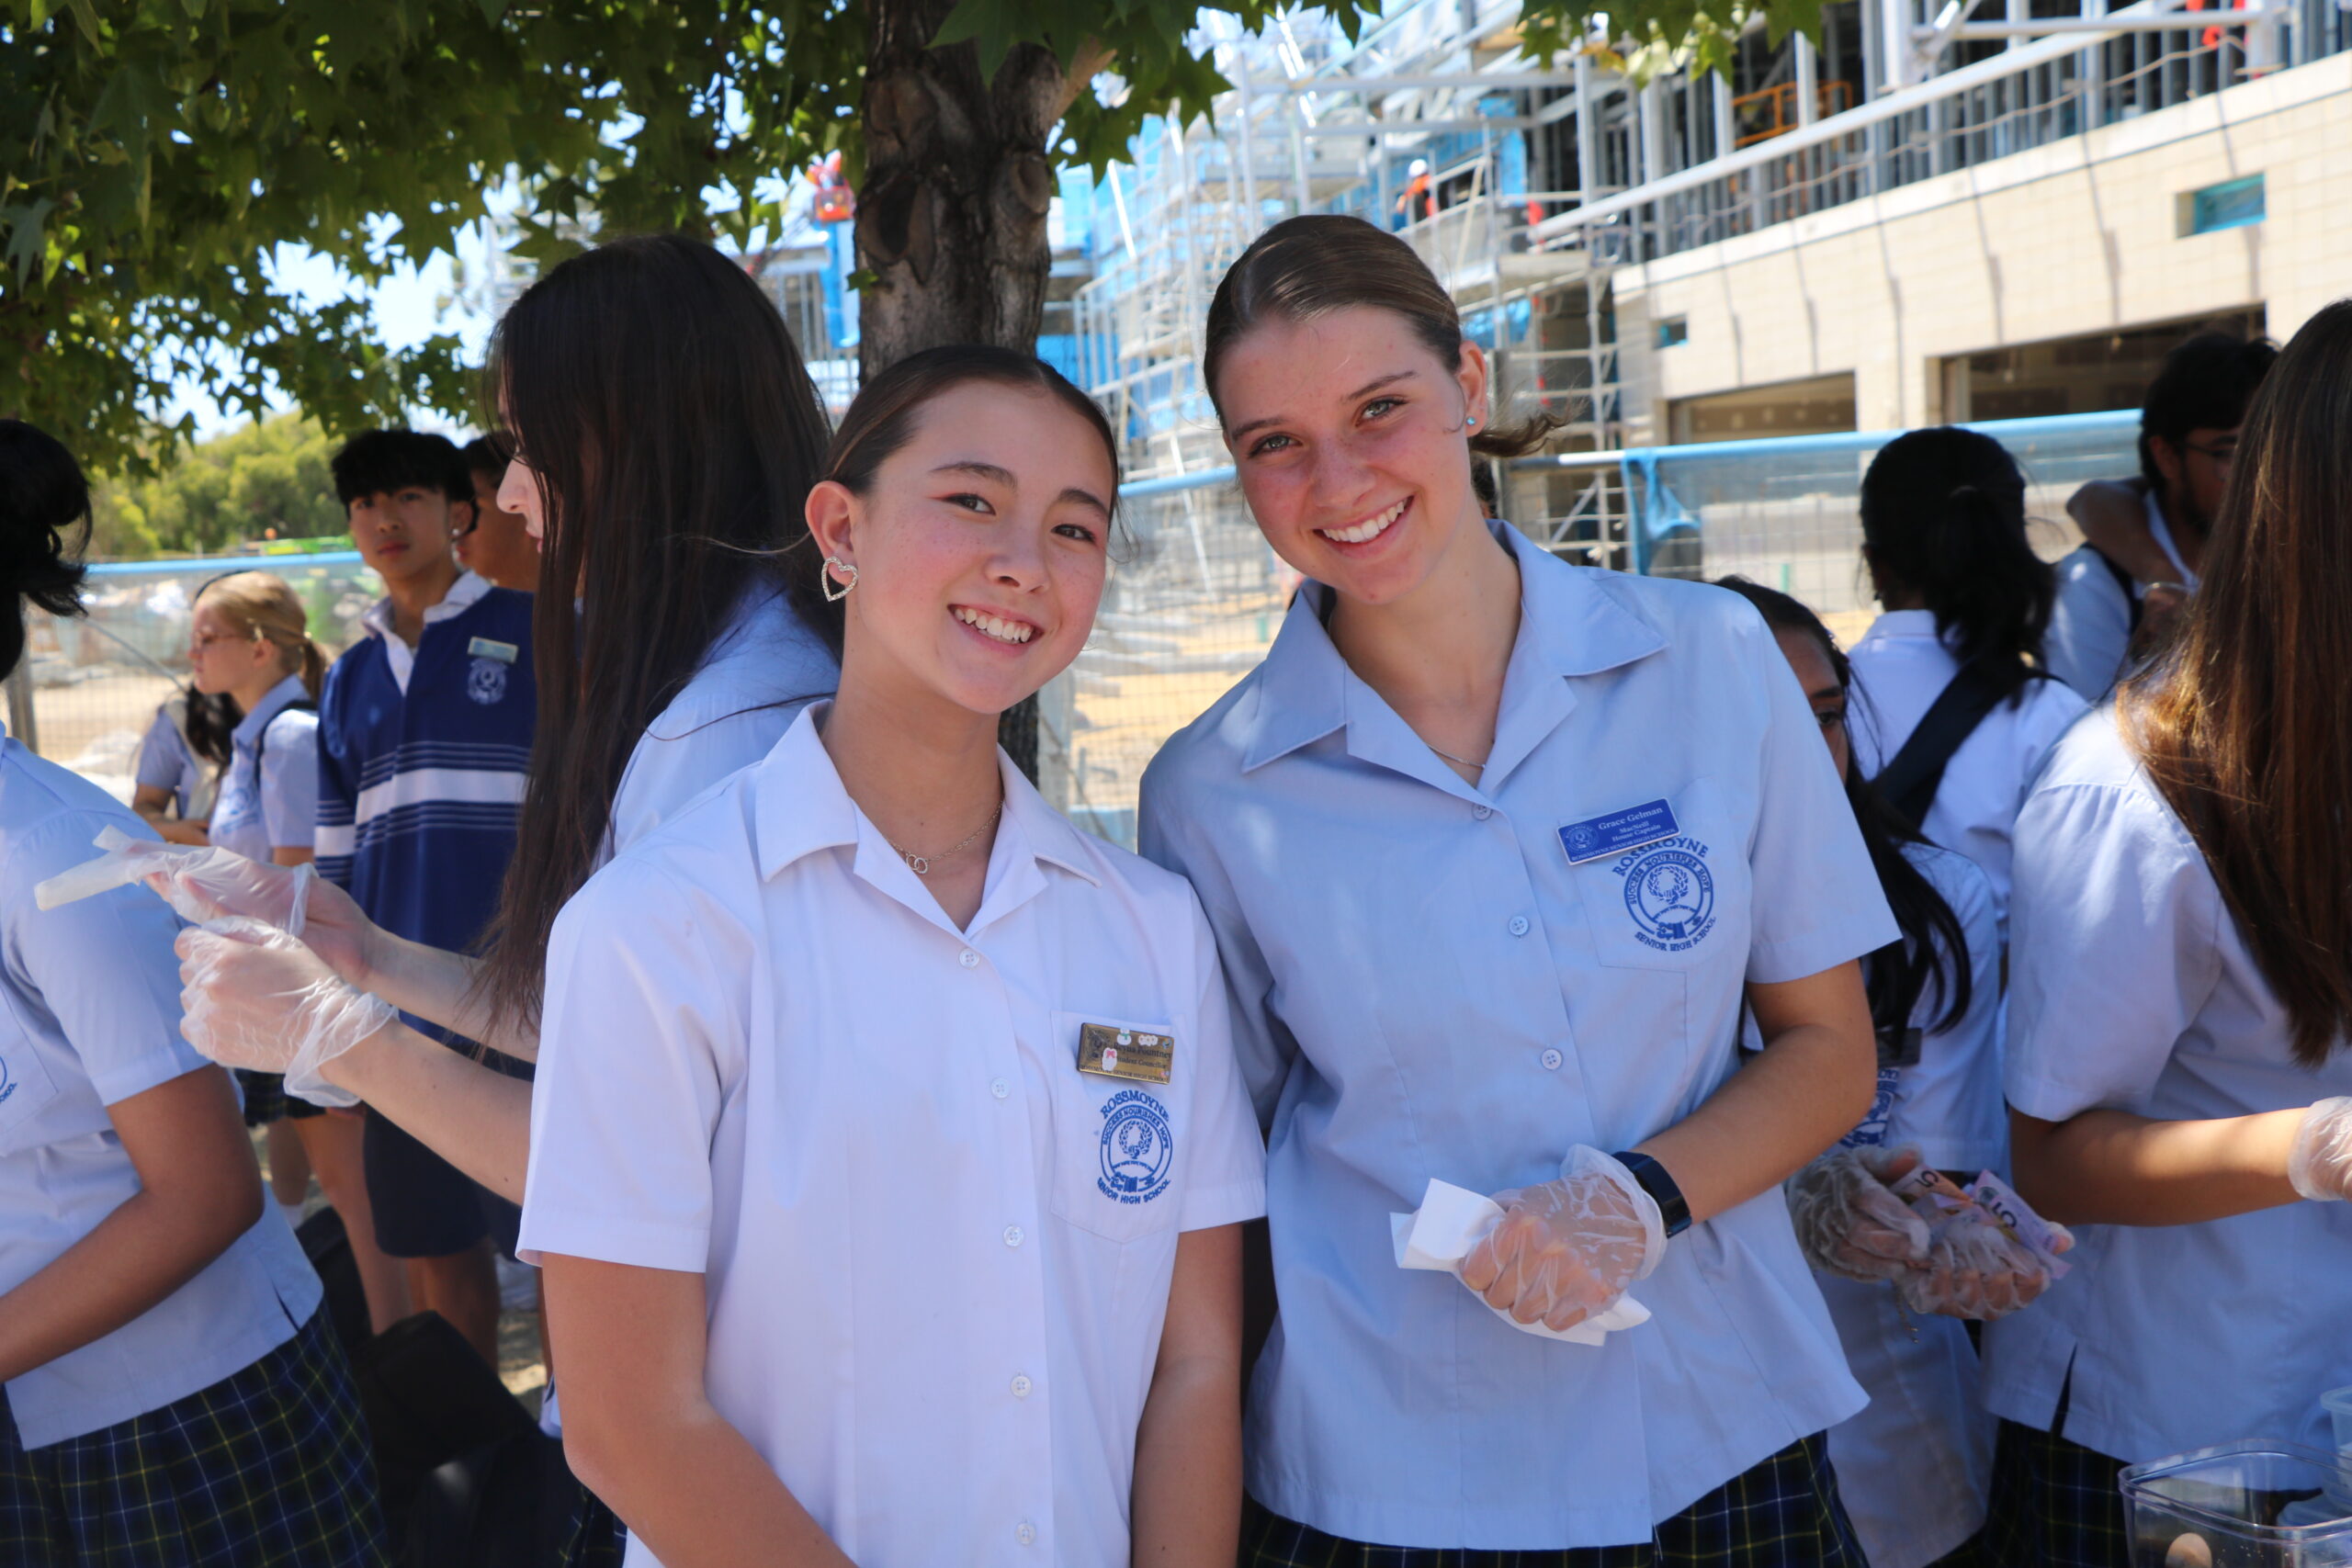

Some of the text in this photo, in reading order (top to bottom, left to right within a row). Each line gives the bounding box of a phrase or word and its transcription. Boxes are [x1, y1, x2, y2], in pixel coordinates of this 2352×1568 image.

[1599, 807, 1663, 830] Grace Gelman
[1611, 824, 1661, 842] House Captain
[1628, 853, 1712, 905] SUCCESS NOURISHES HOPE
[1634, 916, 1716, 952] SENIOR HIGH SCHOOL
[1101, 1089, 1170, 1122] ROSSMOYNE
[1102, 1108, 1169, 1149] SUCCESS NOURISHES HOPE
[1097, 1177, 1170, 1204] SENIOR HIGH SCHOOL
[1915, 1170, 1939, 1188] 5
